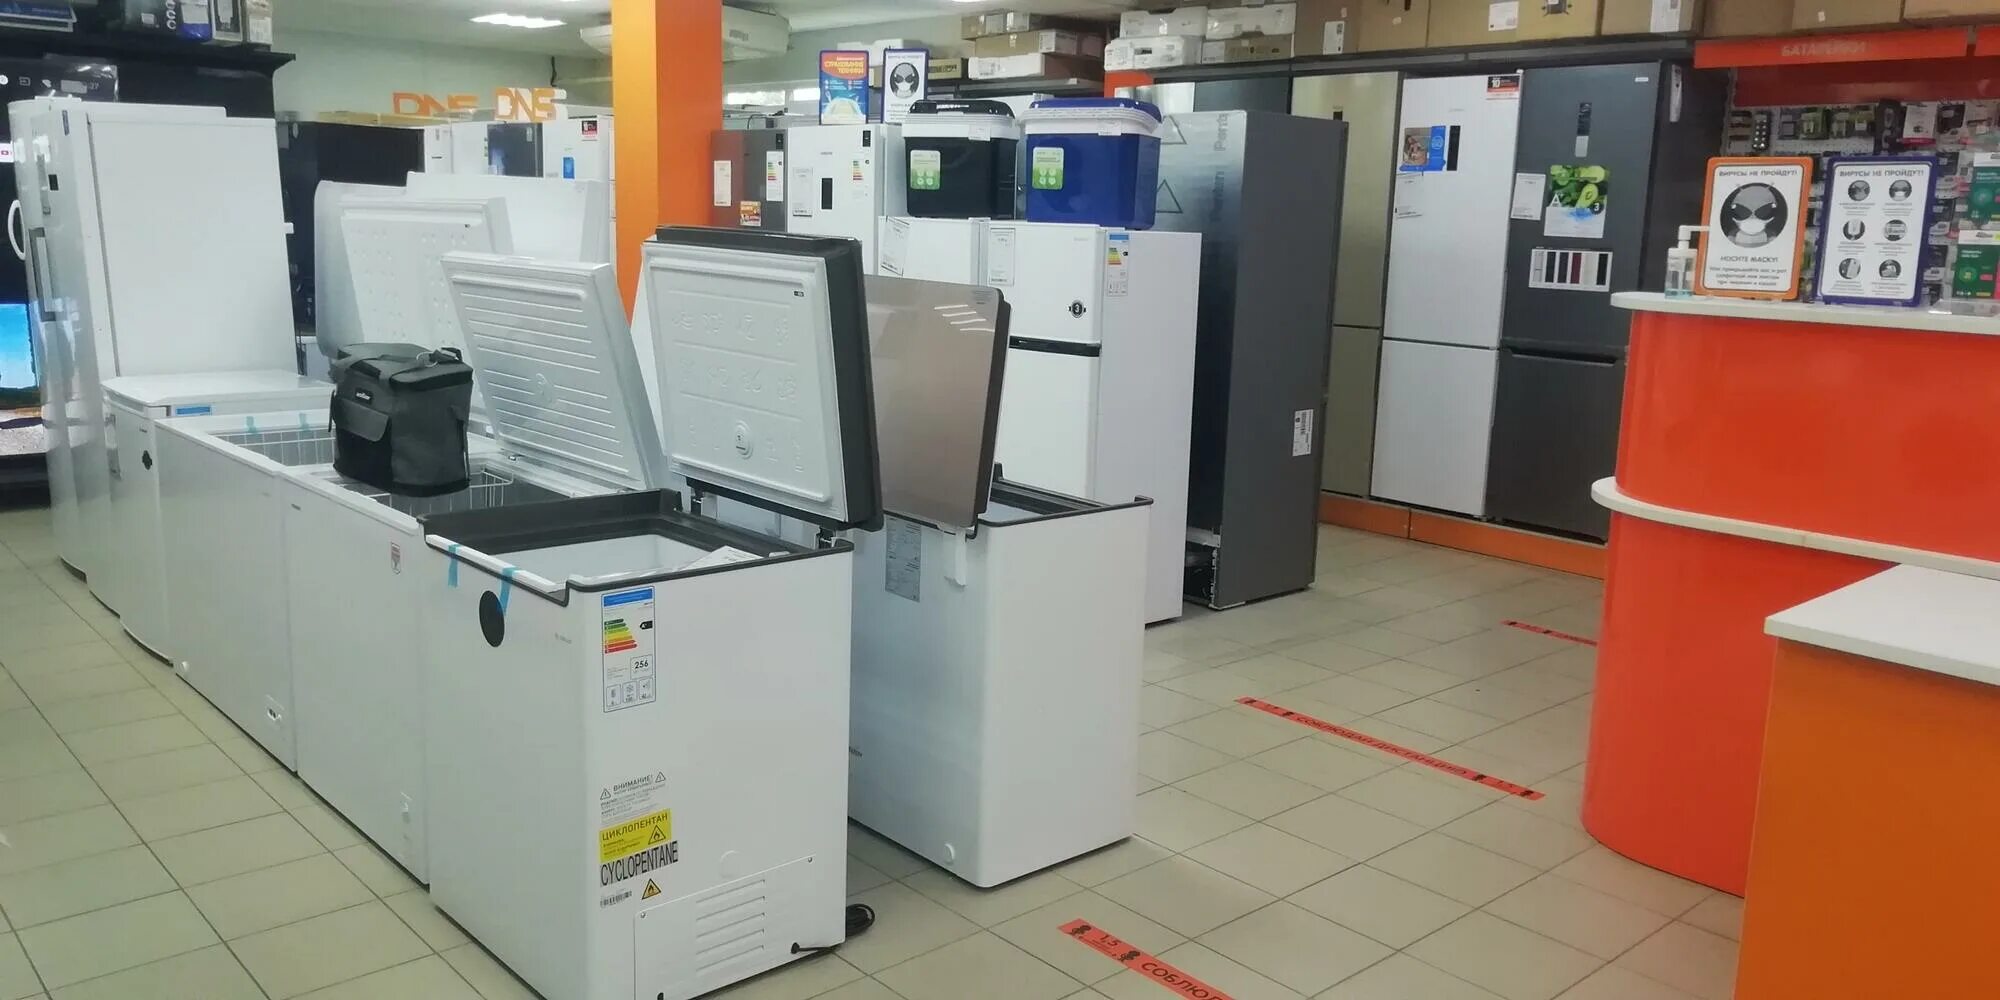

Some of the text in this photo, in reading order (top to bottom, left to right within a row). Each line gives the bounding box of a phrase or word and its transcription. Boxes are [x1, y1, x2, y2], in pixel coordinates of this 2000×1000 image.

[393, 92, 479, 116] DNS
[494, 86, 560, 123] DNS
[633, 660, 649, 670] 256
[613, 774, 653, 792] ВНИМАНИЕ!
[602, 812, 668, 841] ЦИКЛОПЕНТАН
[600, 840, 679, 886] CYCLOPENTANE
